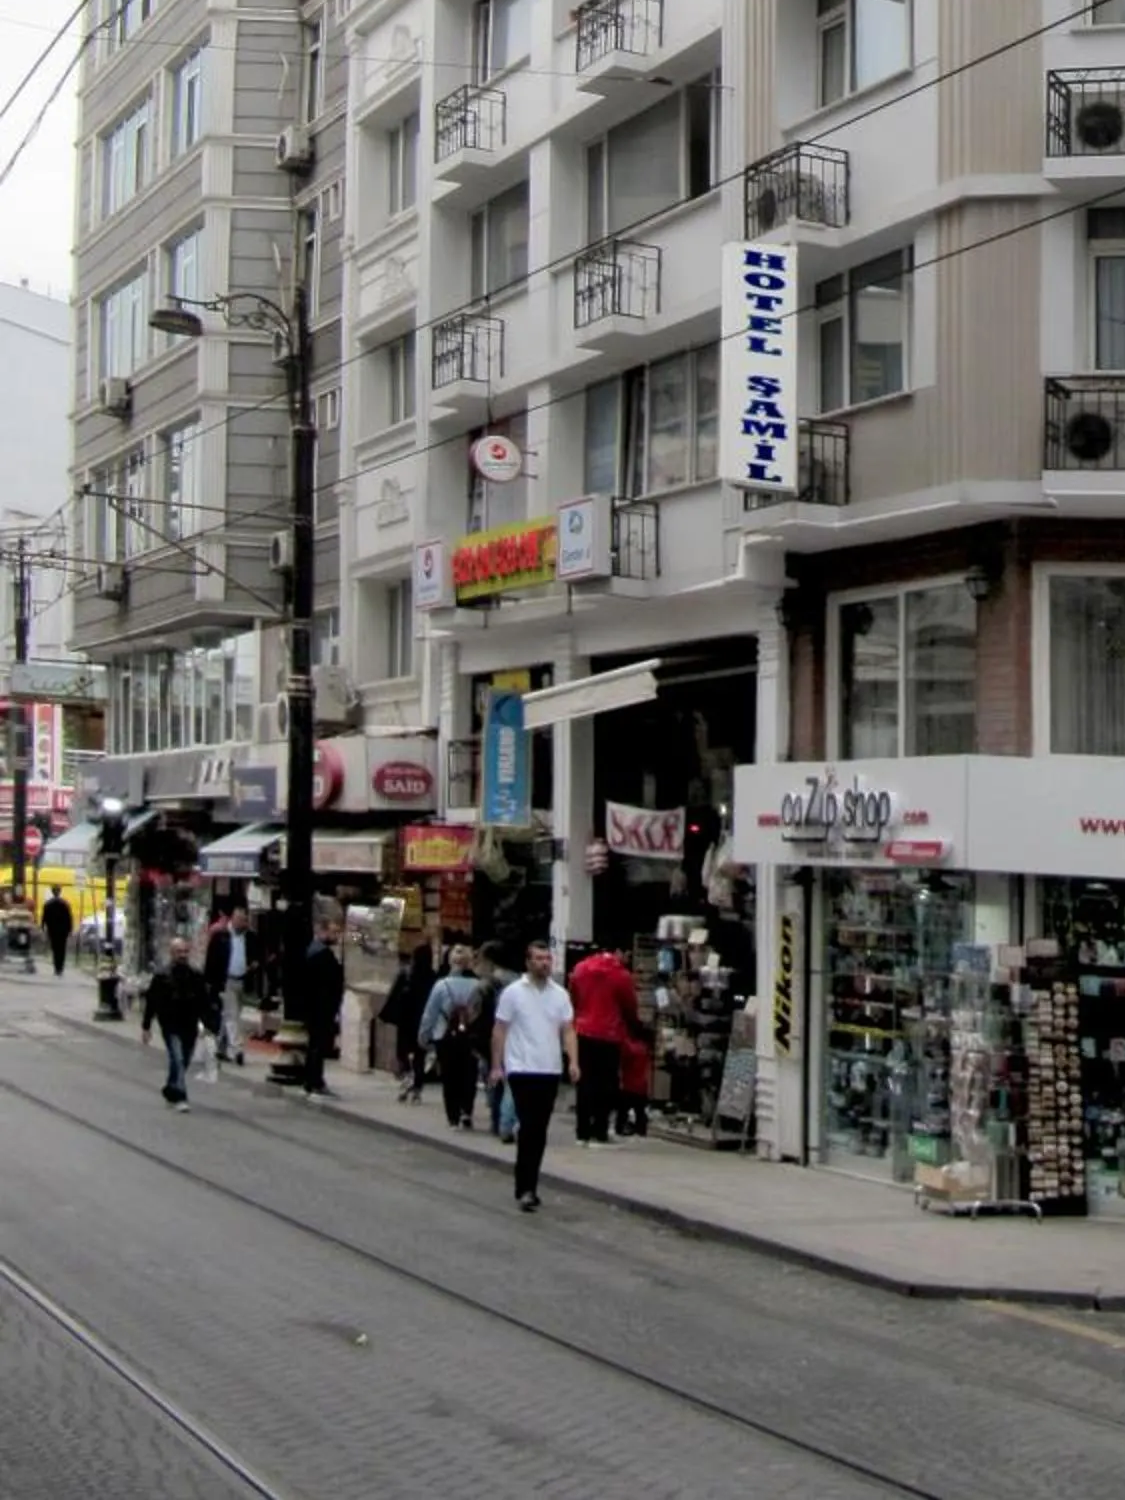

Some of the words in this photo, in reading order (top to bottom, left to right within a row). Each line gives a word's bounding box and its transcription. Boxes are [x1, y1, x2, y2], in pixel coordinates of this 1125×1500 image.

[743, 250, 786, 356] HOTEL
[741, 376, 788, 483] ŞAMİL
[774, 915, 793, 1055] Nikon
